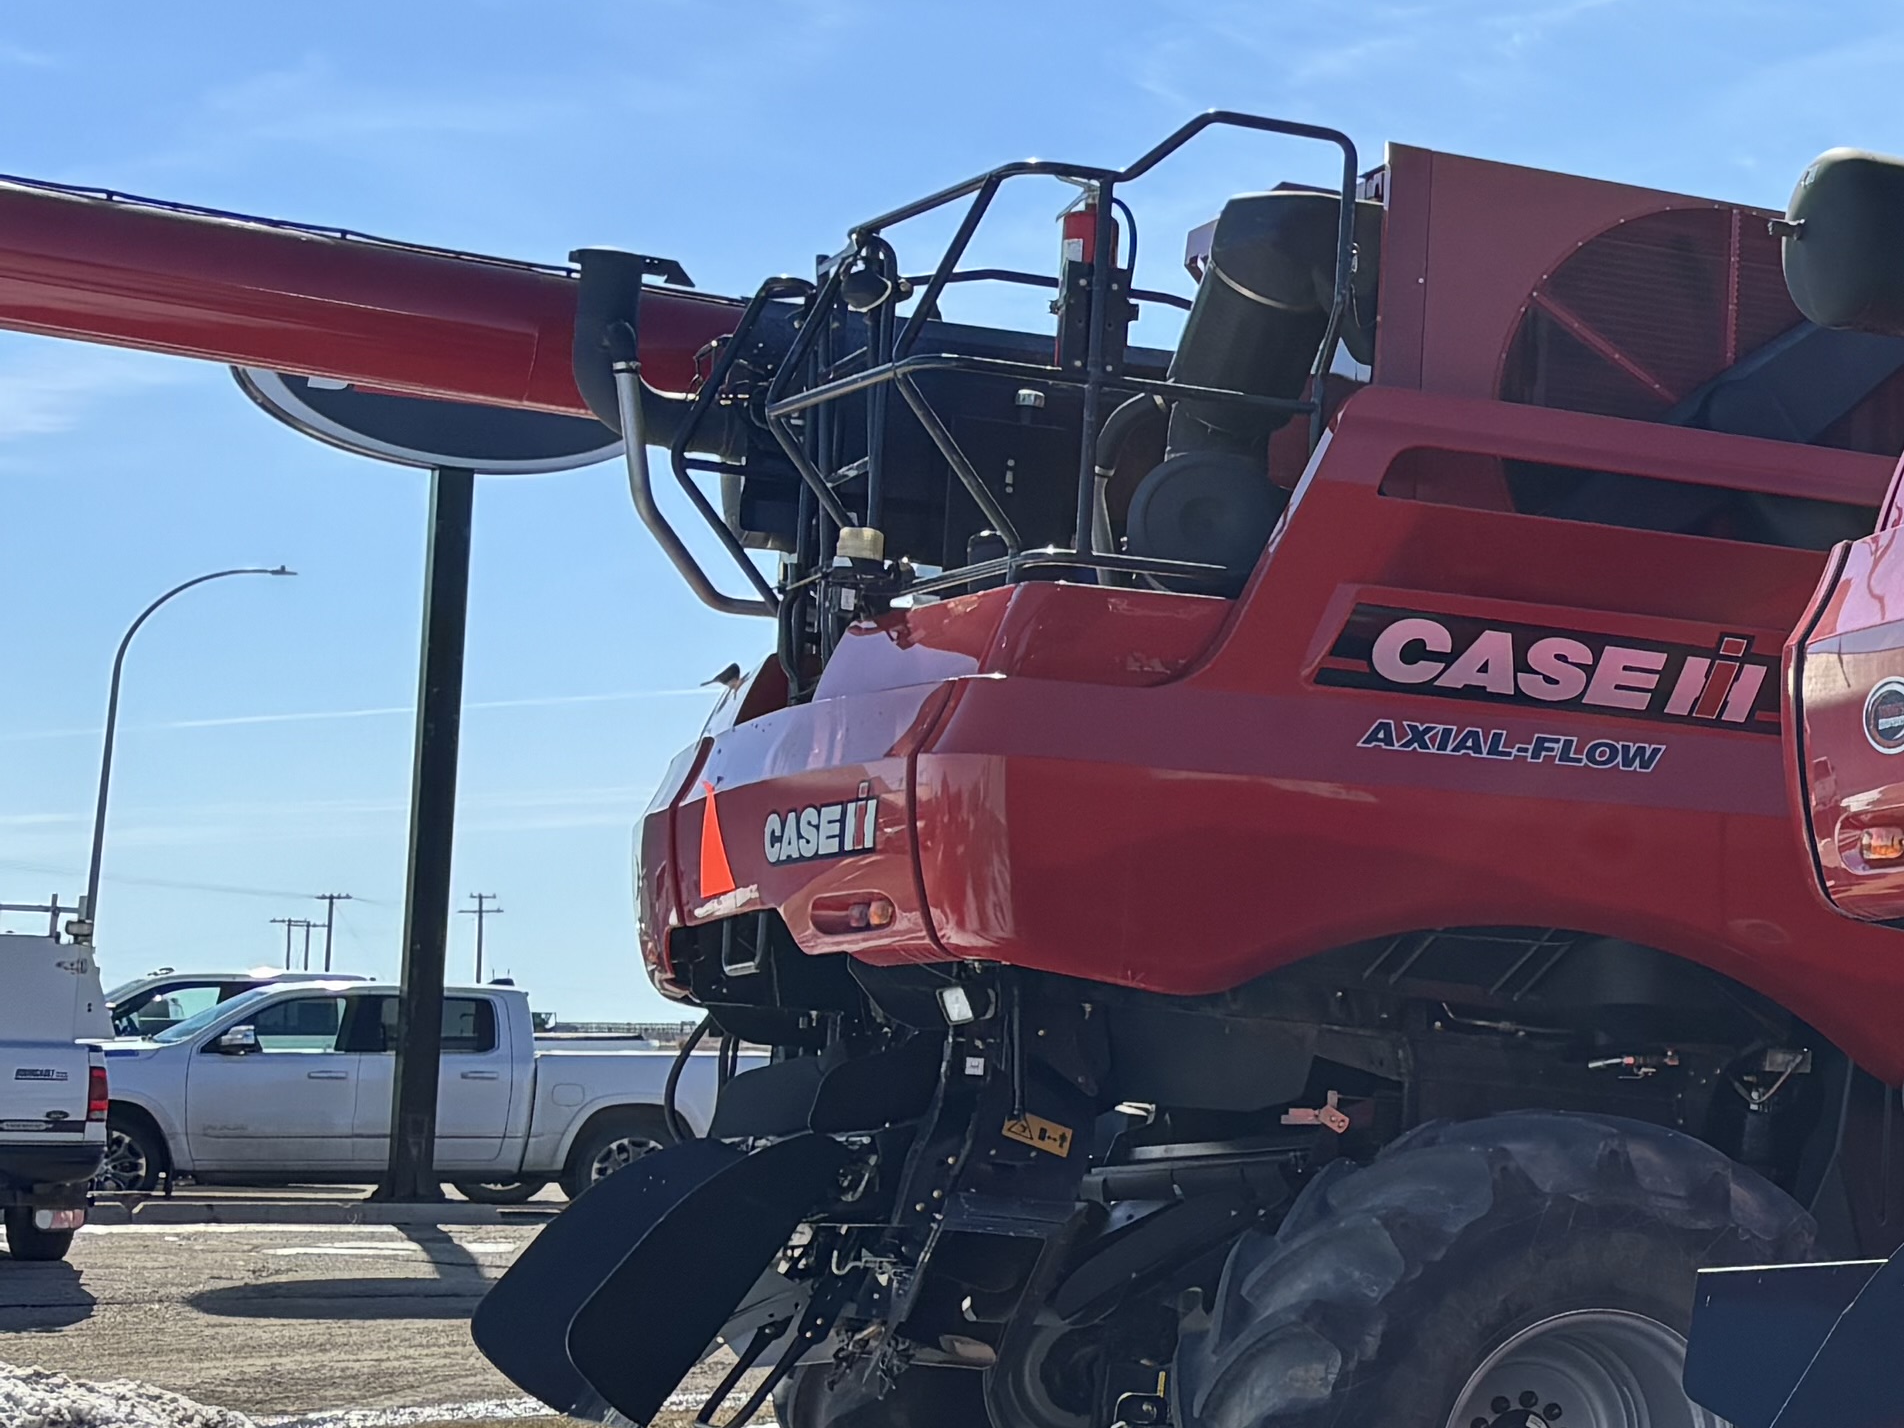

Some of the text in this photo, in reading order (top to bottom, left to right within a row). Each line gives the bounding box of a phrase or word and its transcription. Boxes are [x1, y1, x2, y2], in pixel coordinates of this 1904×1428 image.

[1371, 617, 1668, 710] CASE
[1356, 719, 1666, 773] AXIAL-FLOW
[764, 804, 842, 863] CASE
